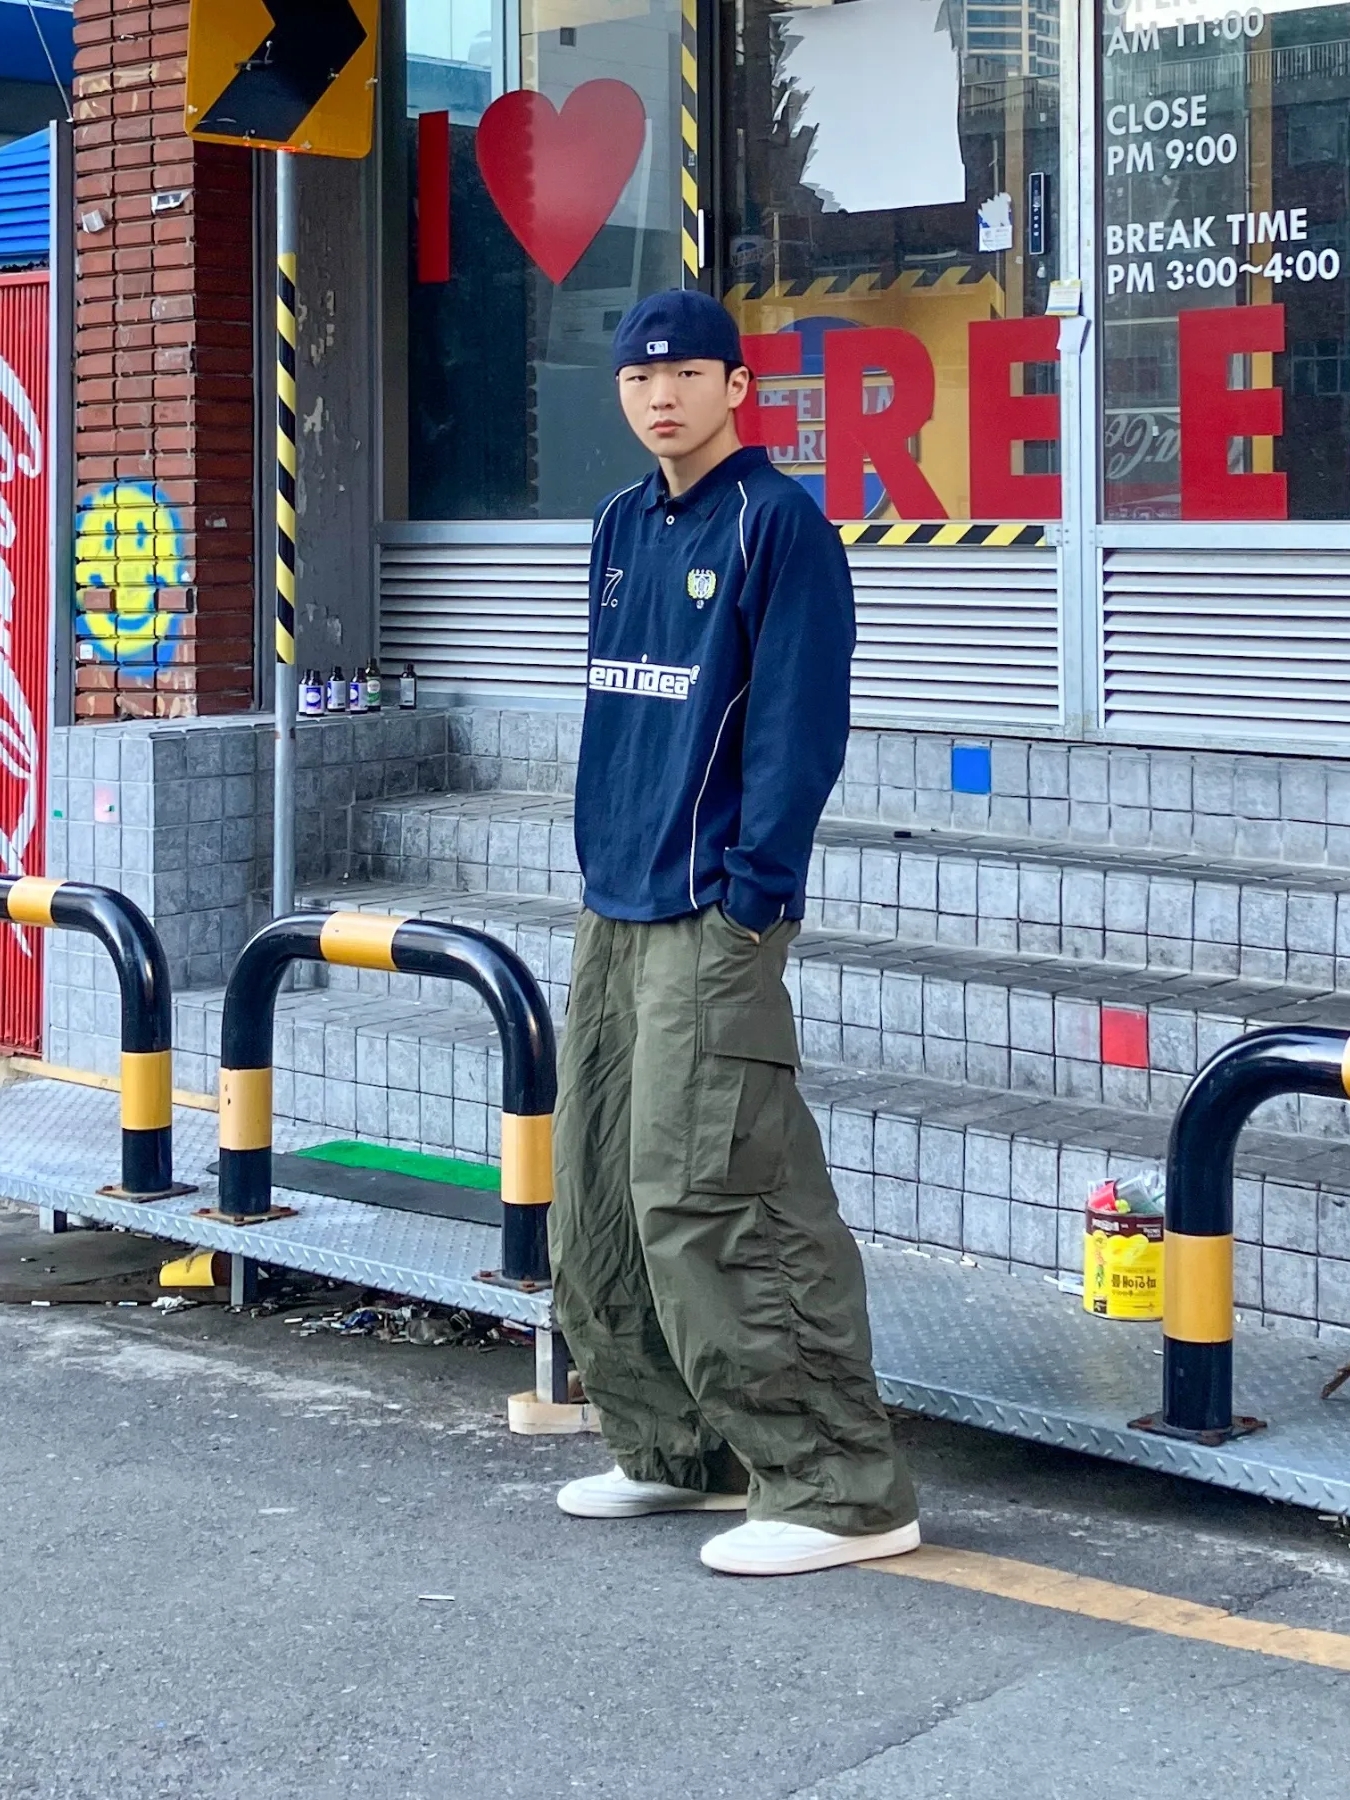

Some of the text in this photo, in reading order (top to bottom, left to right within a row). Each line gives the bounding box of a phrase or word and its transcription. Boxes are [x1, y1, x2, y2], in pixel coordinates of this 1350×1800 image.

[1105, 21, 1160, 57] AM
[1175, 7, 1265, 47] 11:00
[1106, 94, 1207, 135] CLOSE
[1107, 133, 1237, 176] PM 9:00
[1106, 207, 1308, 256] BREAK TIME
[1107, 248, 1340, 294] PM 3:00~4:00
